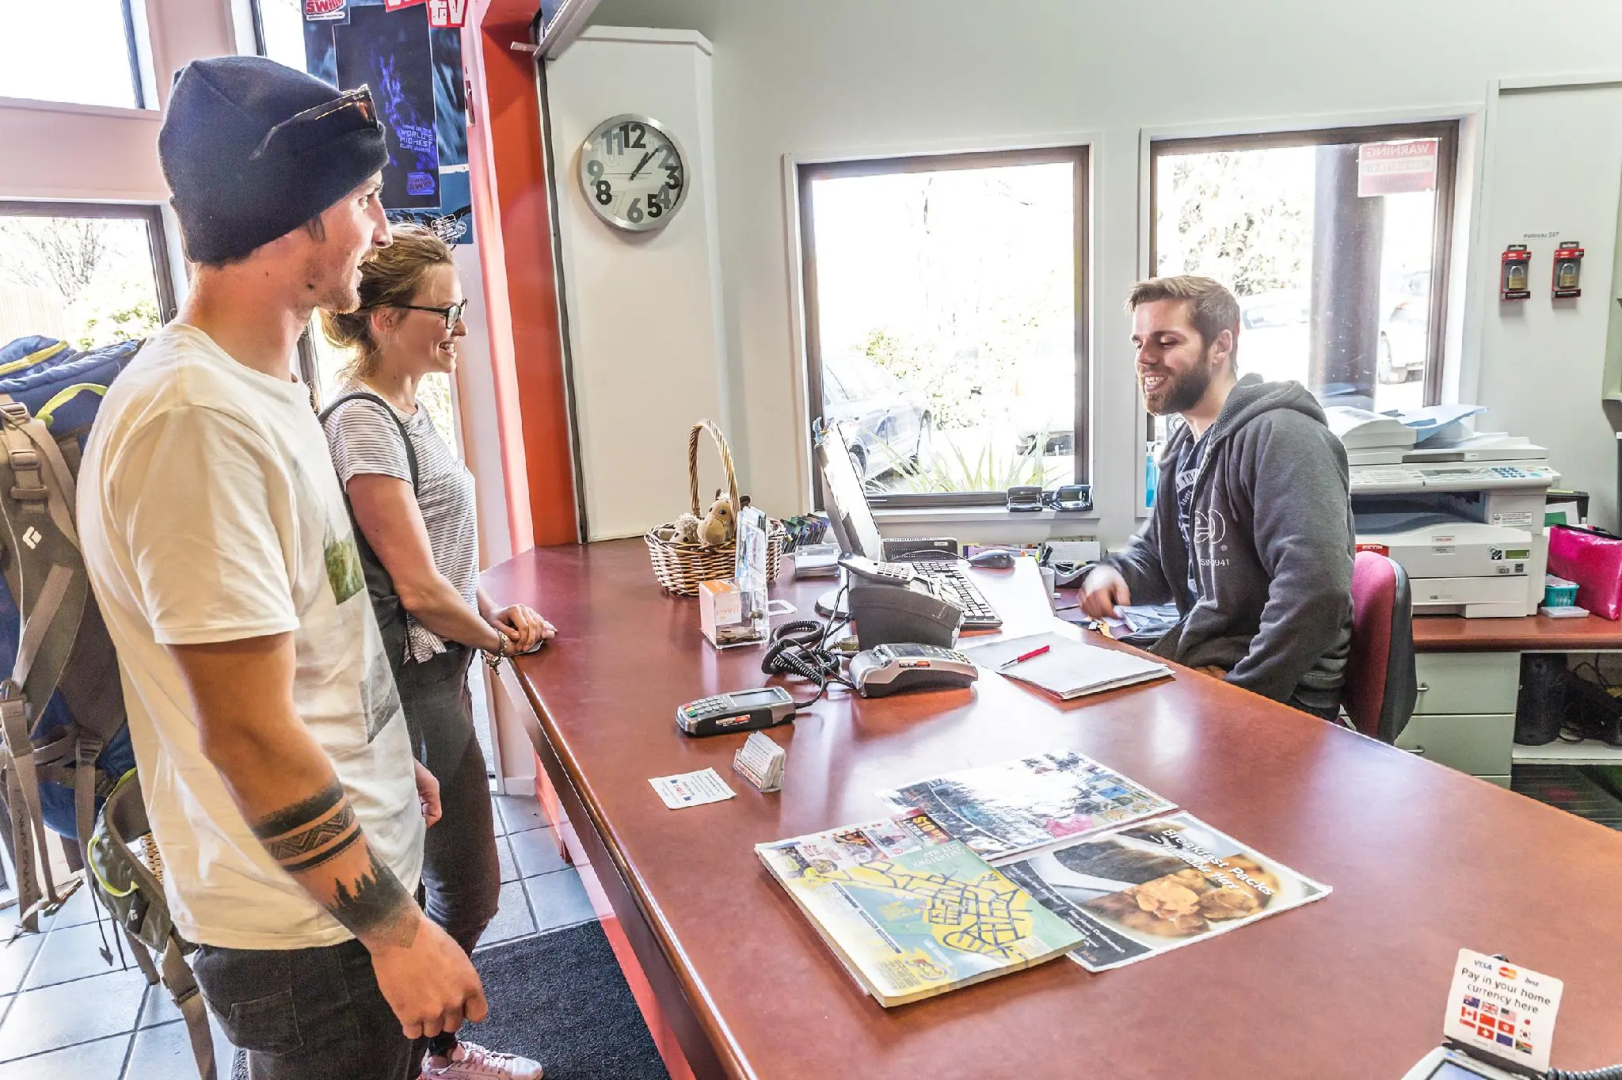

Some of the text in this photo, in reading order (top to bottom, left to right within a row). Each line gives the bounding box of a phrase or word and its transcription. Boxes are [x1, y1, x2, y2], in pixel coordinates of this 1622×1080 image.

[400, 137, 433, 148] HIGHEST
[401, 129, 433, 141] WORLD'S
[601, 129, 624, 155] 11
[619, 124, 646, 148] 12
[658, 145, 674, 170] 2
[588, 160, 604, 186] 9
[665, 166, 680, 190] 3
[596, 180, 612, 205] 8
[657, 185, 671, 209] 4
[627, 198, 644, 223] 6
[647, 194, 662, 218] 5
[1162, 828, 1275, 896] Breakfast Packs
[1474, 960, 1492, 970] VISA
[1461, 967, 1551, 1006] Pay in your home
[1467, 983, 1539, 1014] currency here
